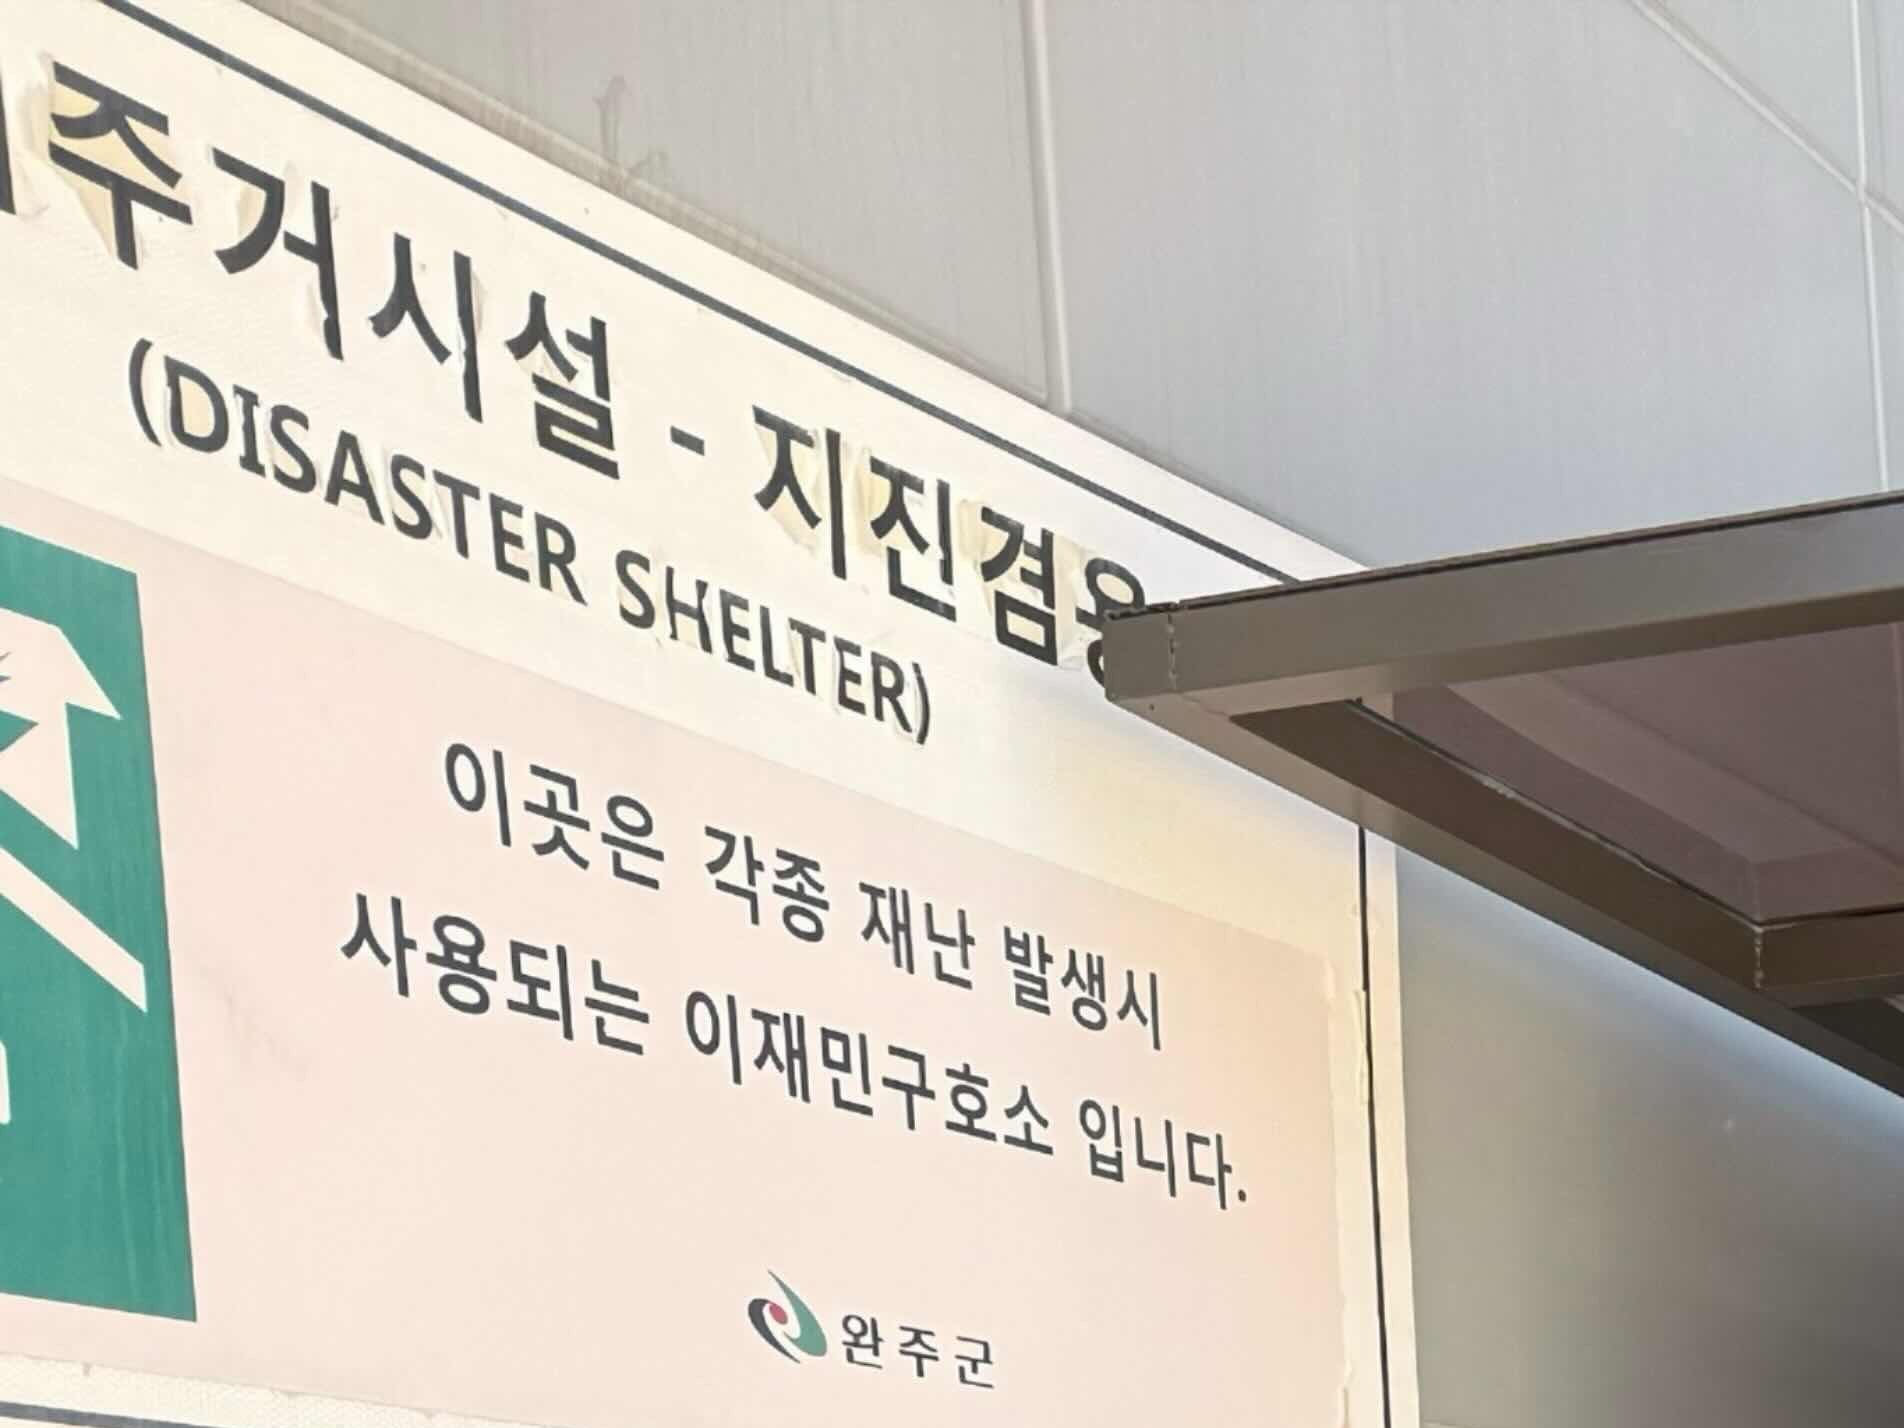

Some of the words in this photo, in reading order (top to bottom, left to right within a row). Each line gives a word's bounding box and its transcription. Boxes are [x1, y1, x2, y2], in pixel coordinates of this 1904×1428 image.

[0, 61, 619, 479] 주거시설
[129, 338, 588, 606] (DISASTER
[616, 549, 930, 744] SHELTER)
[341, 892, 650, 1054] 사용되는
[685, 990, 1054, 1155] 이재민구호소
[1079, 1099, 1247, 1211] 입니다.
[444, 742, 664, 890] 이곳은
[705, 825, 830, 943] 각종
[859, 880, 975, 990] 재난
[1003, 926, 1162, 1050] 발생시
[841, 1314, 993, 1388] 완주군
